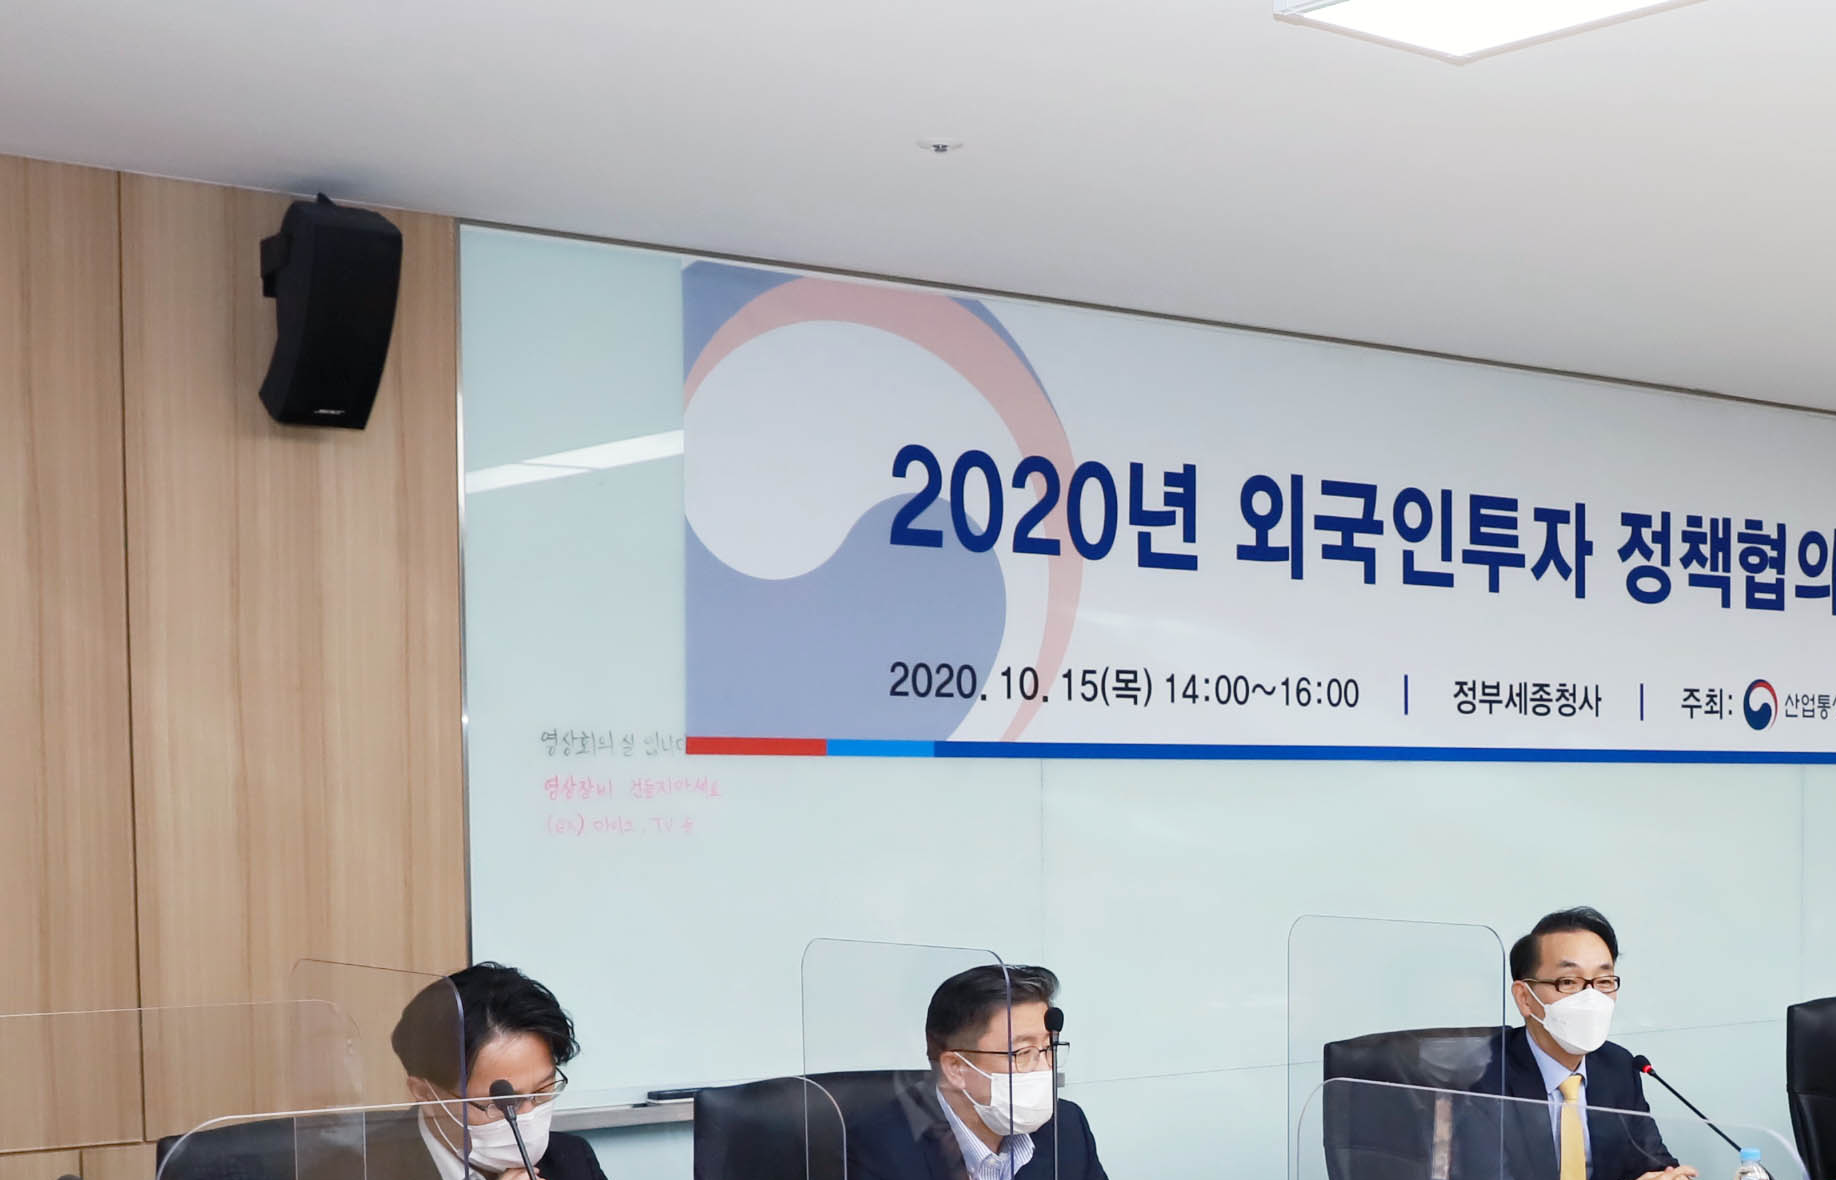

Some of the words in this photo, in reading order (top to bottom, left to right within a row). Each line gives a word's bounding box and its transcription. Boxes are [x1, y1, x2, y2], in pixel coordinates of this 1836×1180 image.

[889, 443, 1200, 571] 2020년
[1236, 473, 1594, 600] 외국인투자
[889, 661, 988, 702] 2020.
[1000, 666, 1049, 702] 10.
[1062, 667, 1153, 706] 15(목)
[1165, 674, 1360, 708] 14:00~16:00
[1452, 679, 1603, 719] 정부세종청사
[1681, 687, 1733, 720] 주최:
